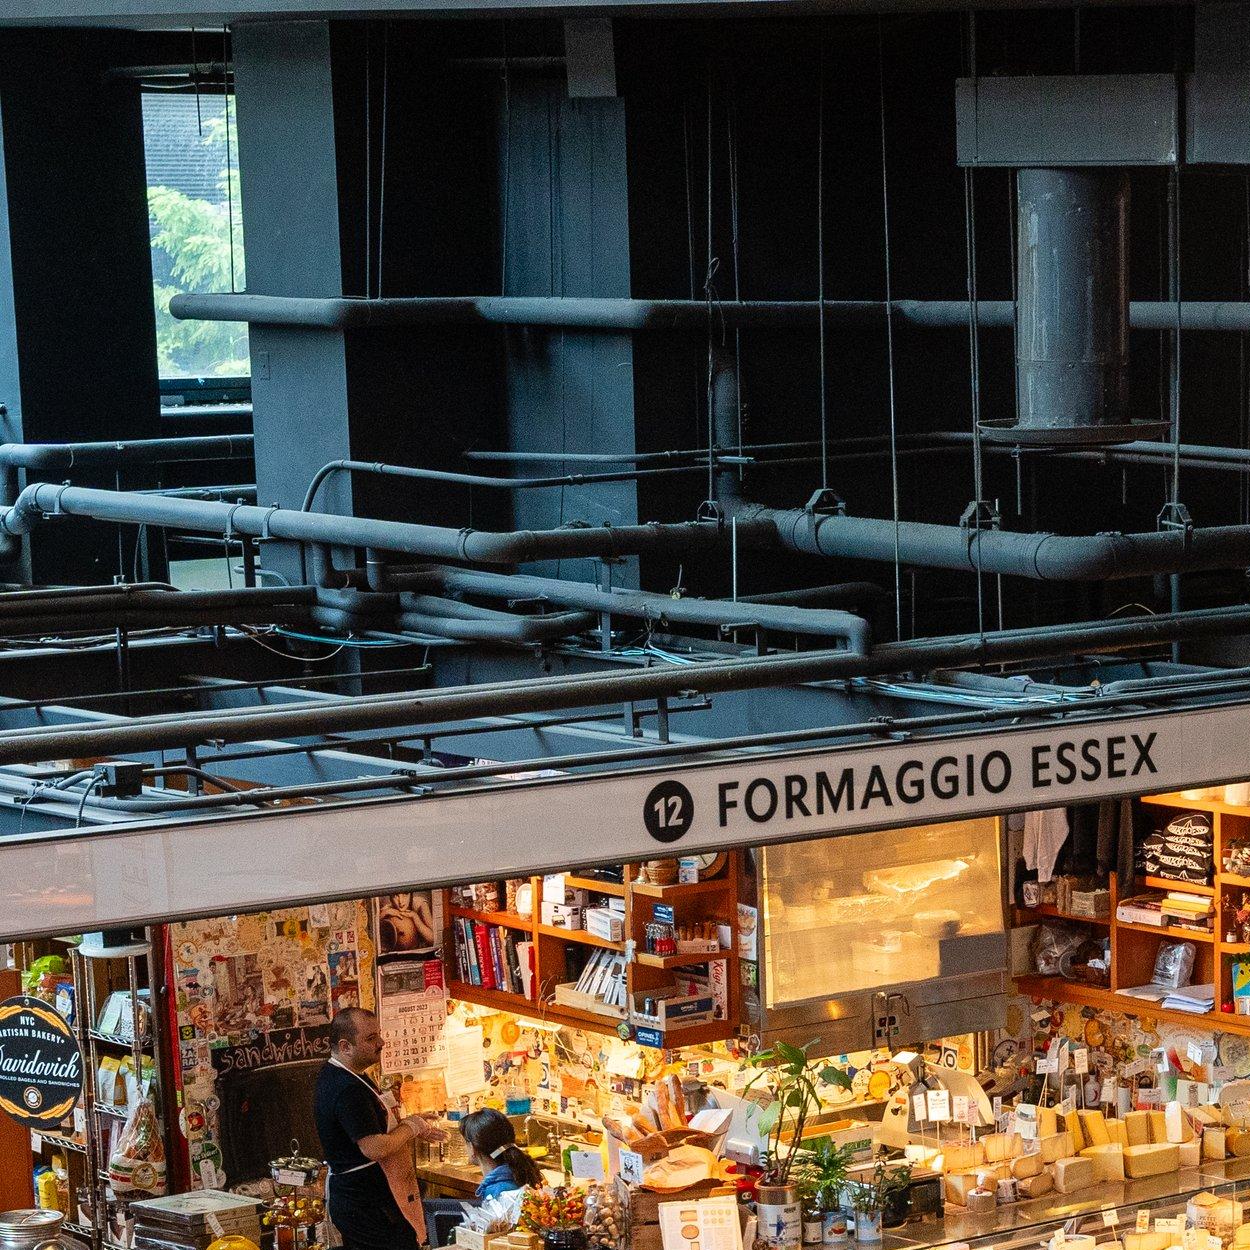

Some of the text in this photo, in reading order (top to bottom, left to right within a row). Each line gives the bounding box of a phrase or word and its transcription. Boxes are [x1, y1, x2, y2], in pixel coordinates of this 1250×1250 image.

[654, 732, 1158, 830] 12 FORMAGGIO ESSEX
[398, 1005, 415, 1013] AUGUST
[20, 1015, 35, 1026] NYC
[31, 1029, 60, 1043] BAKERY
[219, 1028, 331, 1075] sandwiches
